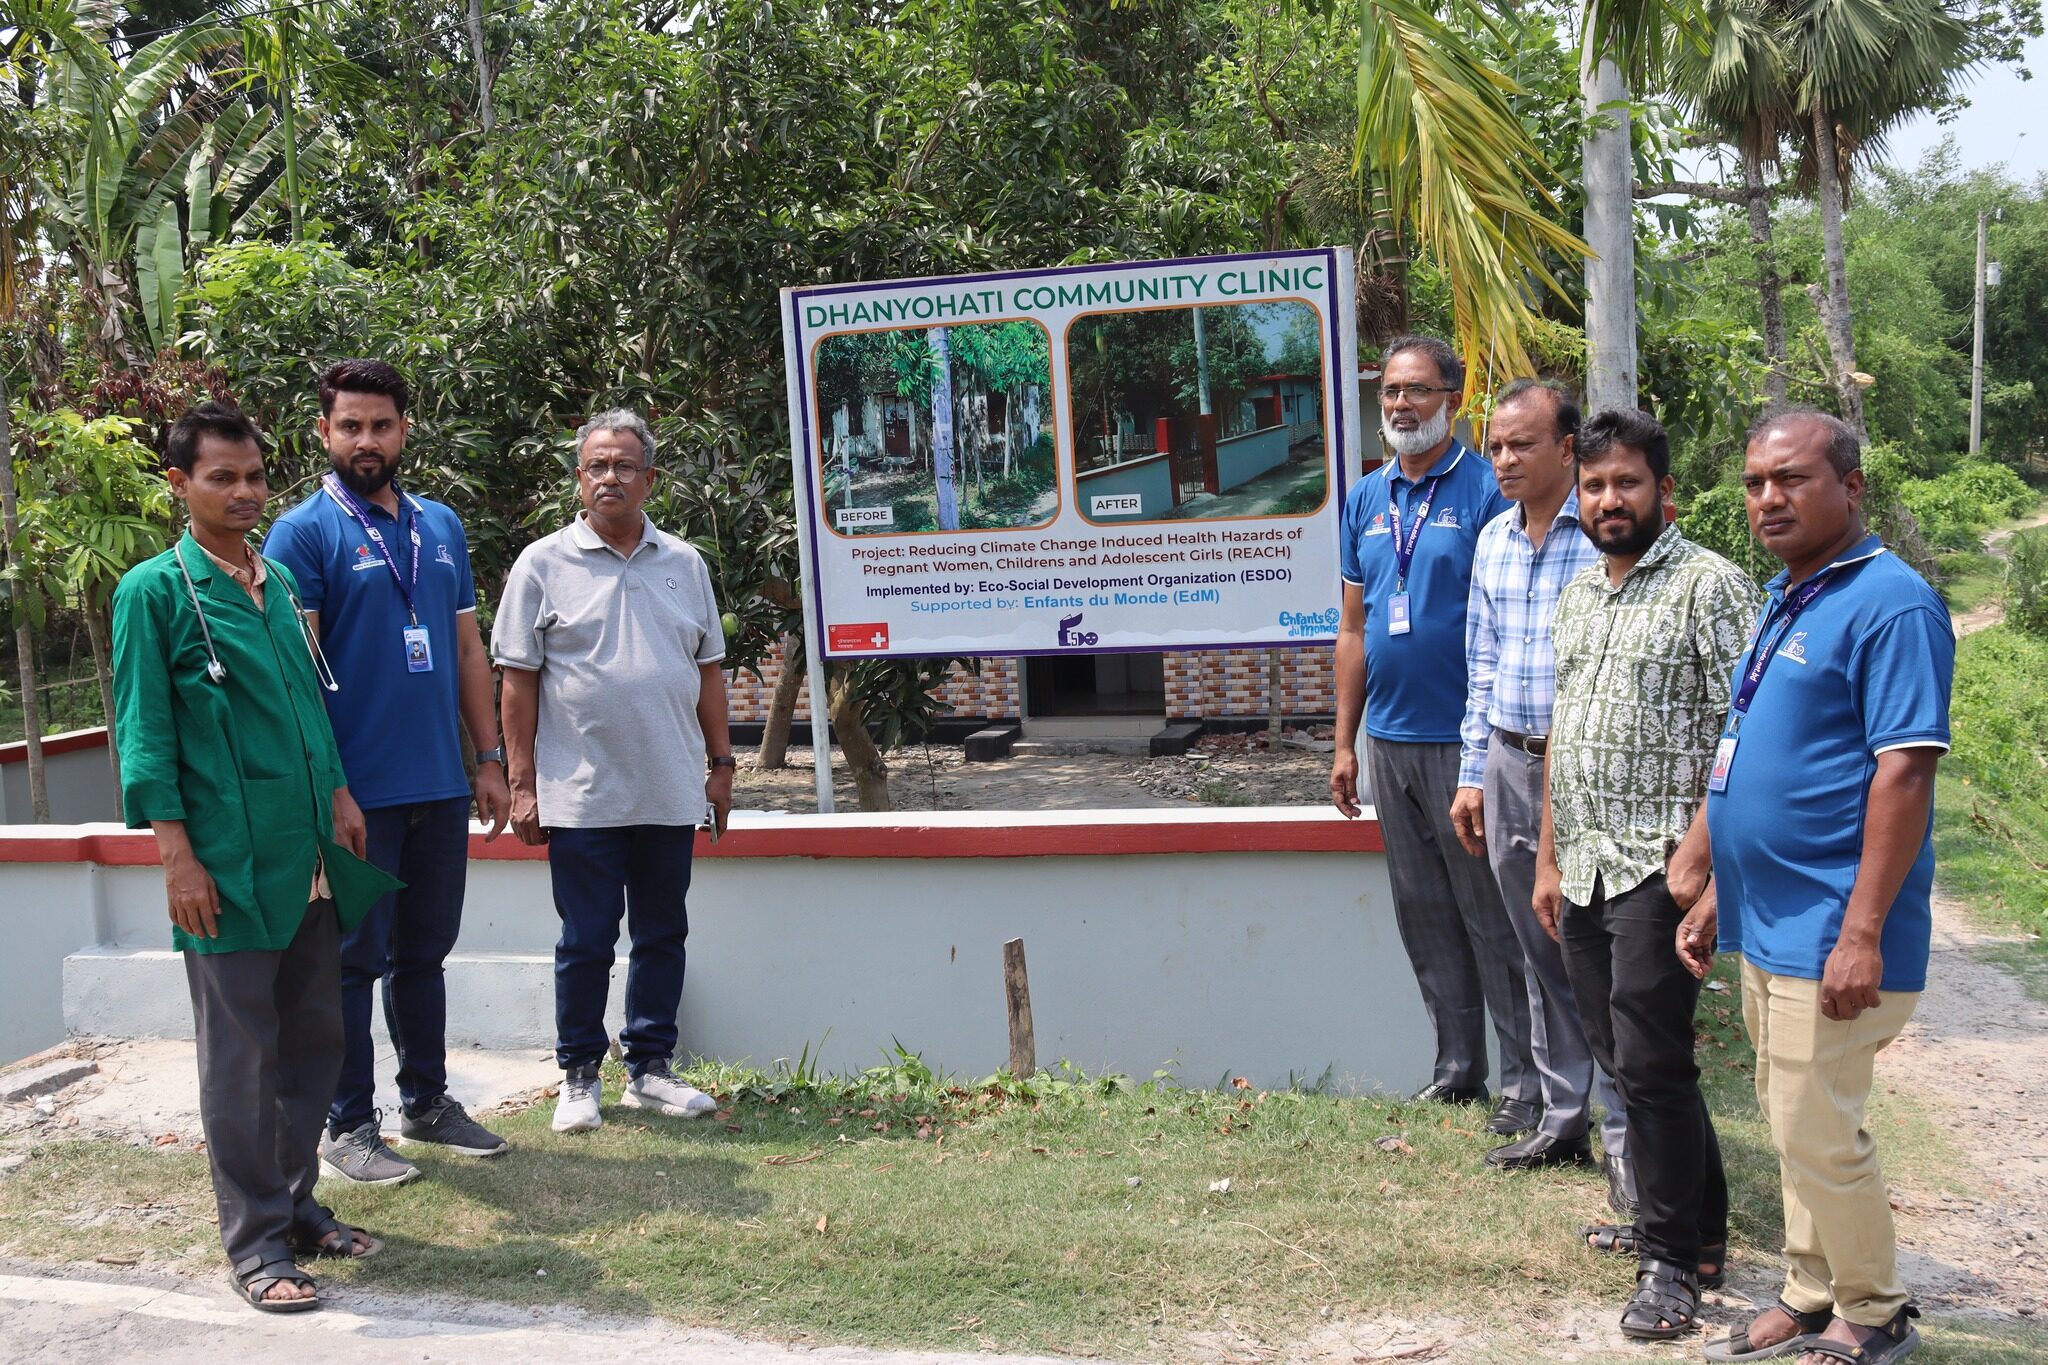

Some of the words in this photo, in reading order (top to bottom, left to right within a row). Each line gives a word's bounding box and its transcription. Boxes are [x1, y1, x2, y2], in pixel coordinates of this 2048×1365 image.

[806, 290, 1003, 328] DHANYOHATI
[1013, 274, 1207, 310] COMMUNITY
[1217, 266, 1323, 295] CLINIC
[841, 511, 887, 522] BEFORE
[1095, 499, 1138, 510] AFTER
[852, 547, 905, 560] Project:
[909, 544, 977, 557] Reducing
[980, 541, 1036, 553] Climate
[1040, 537, 1097, 551] Change
[1101, 534, 1163, 548] Induced
[1167, 531, 1217, 544] Health
[1221, 529, 1283, 542] Hazards
[1287, 527, 1303, 539] of
[863, 562, 929, 576] Pregnant
[932, 559, 993, 571] Women,
[996, 556, 1065, 569] Childrens
[1069, 554, 1096, 566] and
[1101, 551, 1185, 565] Adolescent
[1190, 549, 1223, 561] Girls
[1227, 545, 1291, 561] (REACH)
[866, 583, 950, 599] Implemented
[954, 582, 974, 595] by:
[979, 579, 1049, 592] Eco-Social
[1053, 574, 1143, 590] Development
[1147, 571, 1236, 587] Organization
[1240, 568, 1292, 584] (ESDO)
[911, 598, 991, 613] Supported
[997, 597, 1019, 610] by:
[1024, 595, 1083, 608] Enfants
[1089, 594, 1109, 605] du
[1114, 592, 1168, 605] Monde
[1173, 589, 1220, 605] (EdM)
